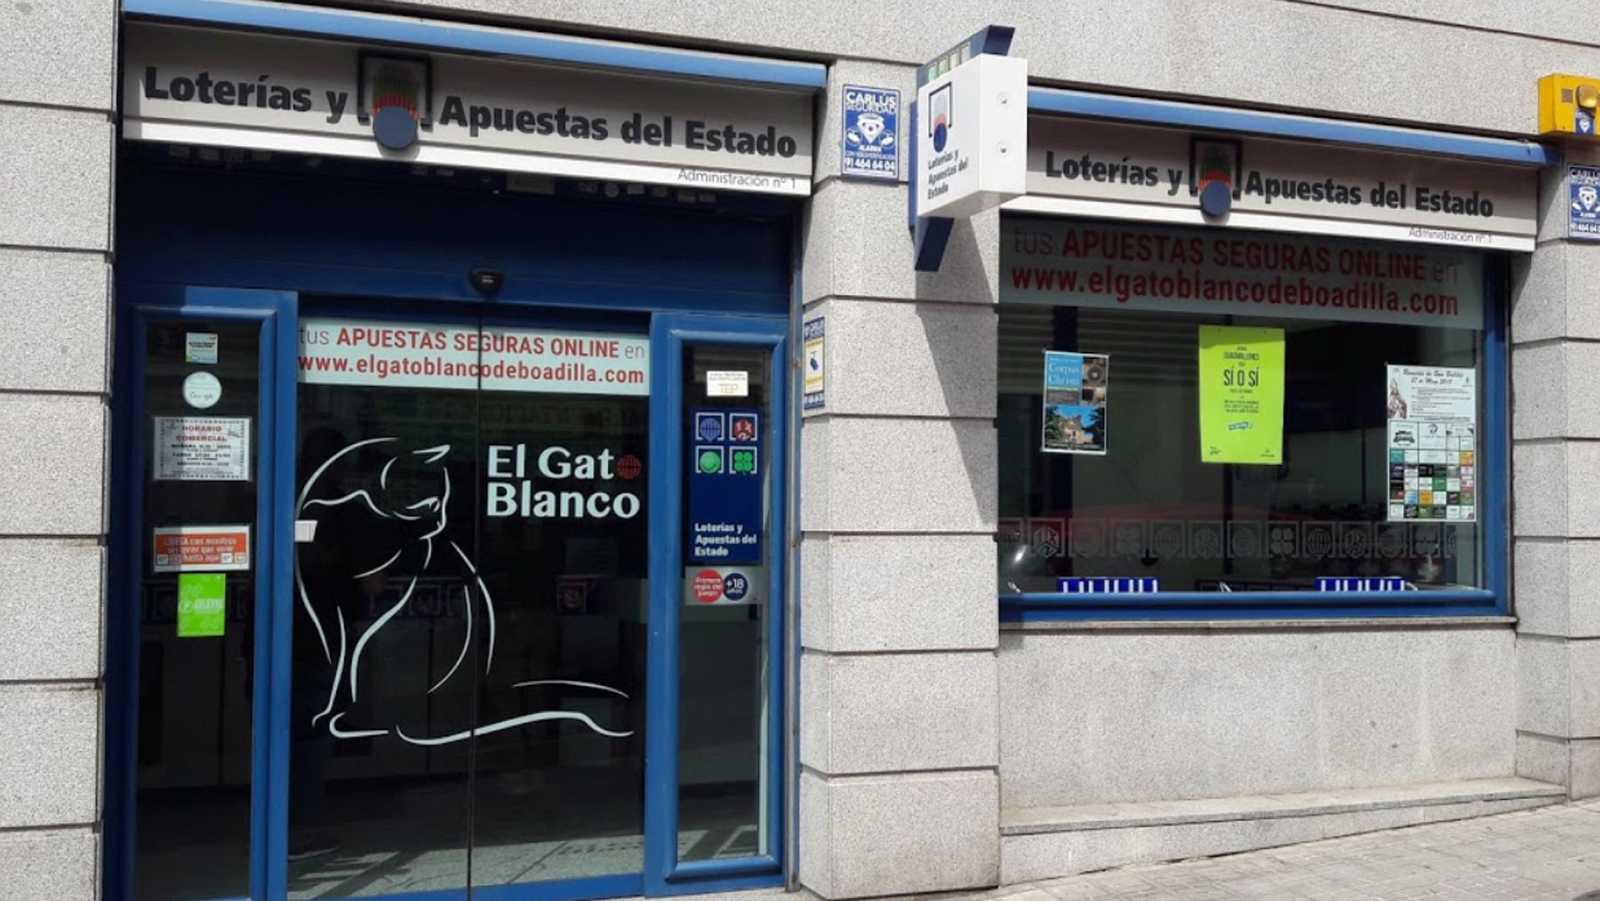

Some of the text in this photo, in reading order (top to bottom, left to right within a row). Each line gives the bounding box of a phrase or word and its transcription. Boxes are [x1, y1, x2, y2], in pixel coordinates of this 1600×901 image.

[145, 66, 797, 158] Loterías y Apuestas del Estado
[677, 168, 769, 187] Administración
[1046, 151, 1494, 218] Loterías y Apuestas del Estado
[1062, 228, 1204, 265] APUESTAS
[1212, 238, 1331, 273] SEGURAS
[1339, 249, 1425, 280] ONLINE
[1011, 264, 1458, 316] www.elgatoblancodeboadilla.com
[299, 327, 645, 359] tus APUESTAS SEGURAS ONLINE en
[298, 353, 644, 384] www.elgatoblancodeboadilla.com
[1224, 365, 1260, 388] SÍ O SÍ
[487, 443, 526, 478] El
[487, 480, 641, 518] Blanco
[695, 534, 757, 546] Apuestas del
[736, 524, 743, 535] y
[694, 546, 729, 556] Estado
